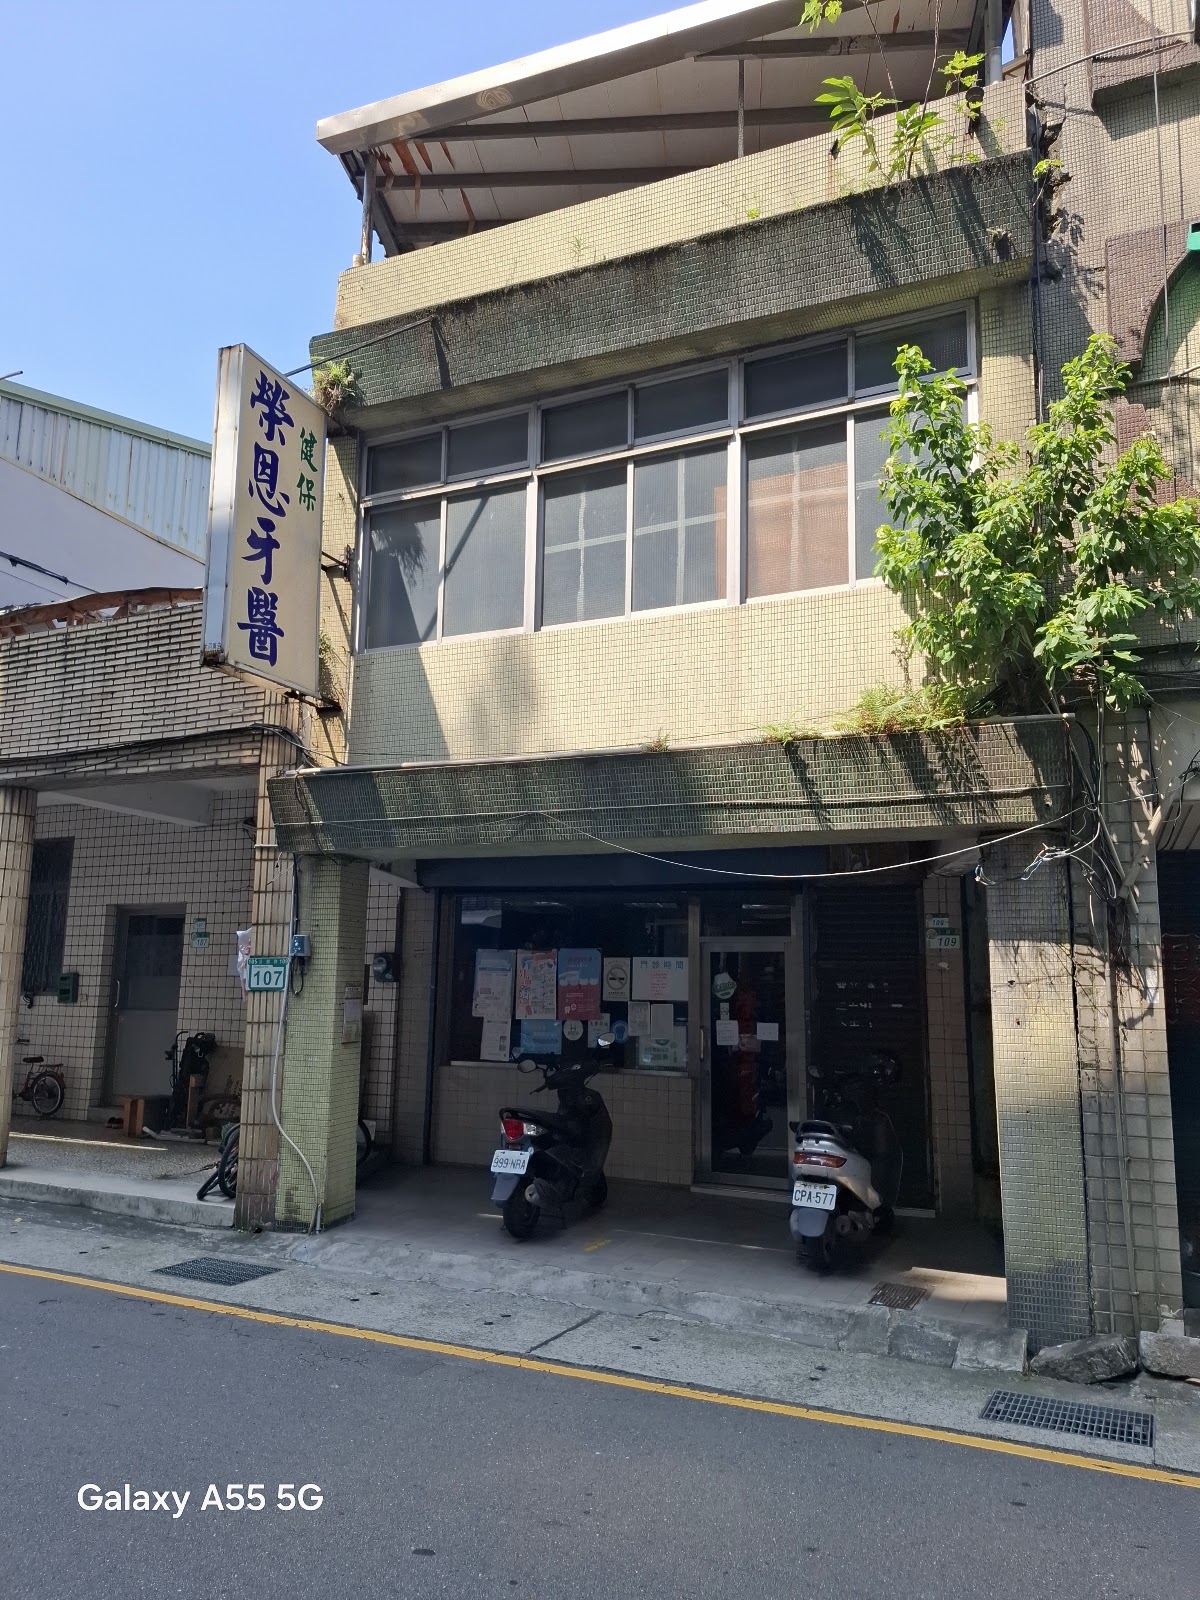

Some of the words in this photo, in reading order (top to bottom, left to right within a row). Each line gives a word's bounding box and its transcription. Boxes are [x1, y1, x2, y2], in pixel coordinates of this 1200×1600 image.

[297, 427, 318, 511] 健保
[237, 370, 295, 666] 榮恩牙醫
[938, 937, 957, 947] 109
[640, 960, 684, 970] 門診時間
[253, 970, 283, 986] 107
[493, 1157, 526, 1170] 999-NRA
[794, 1190, 835, 1206] CPA-577
